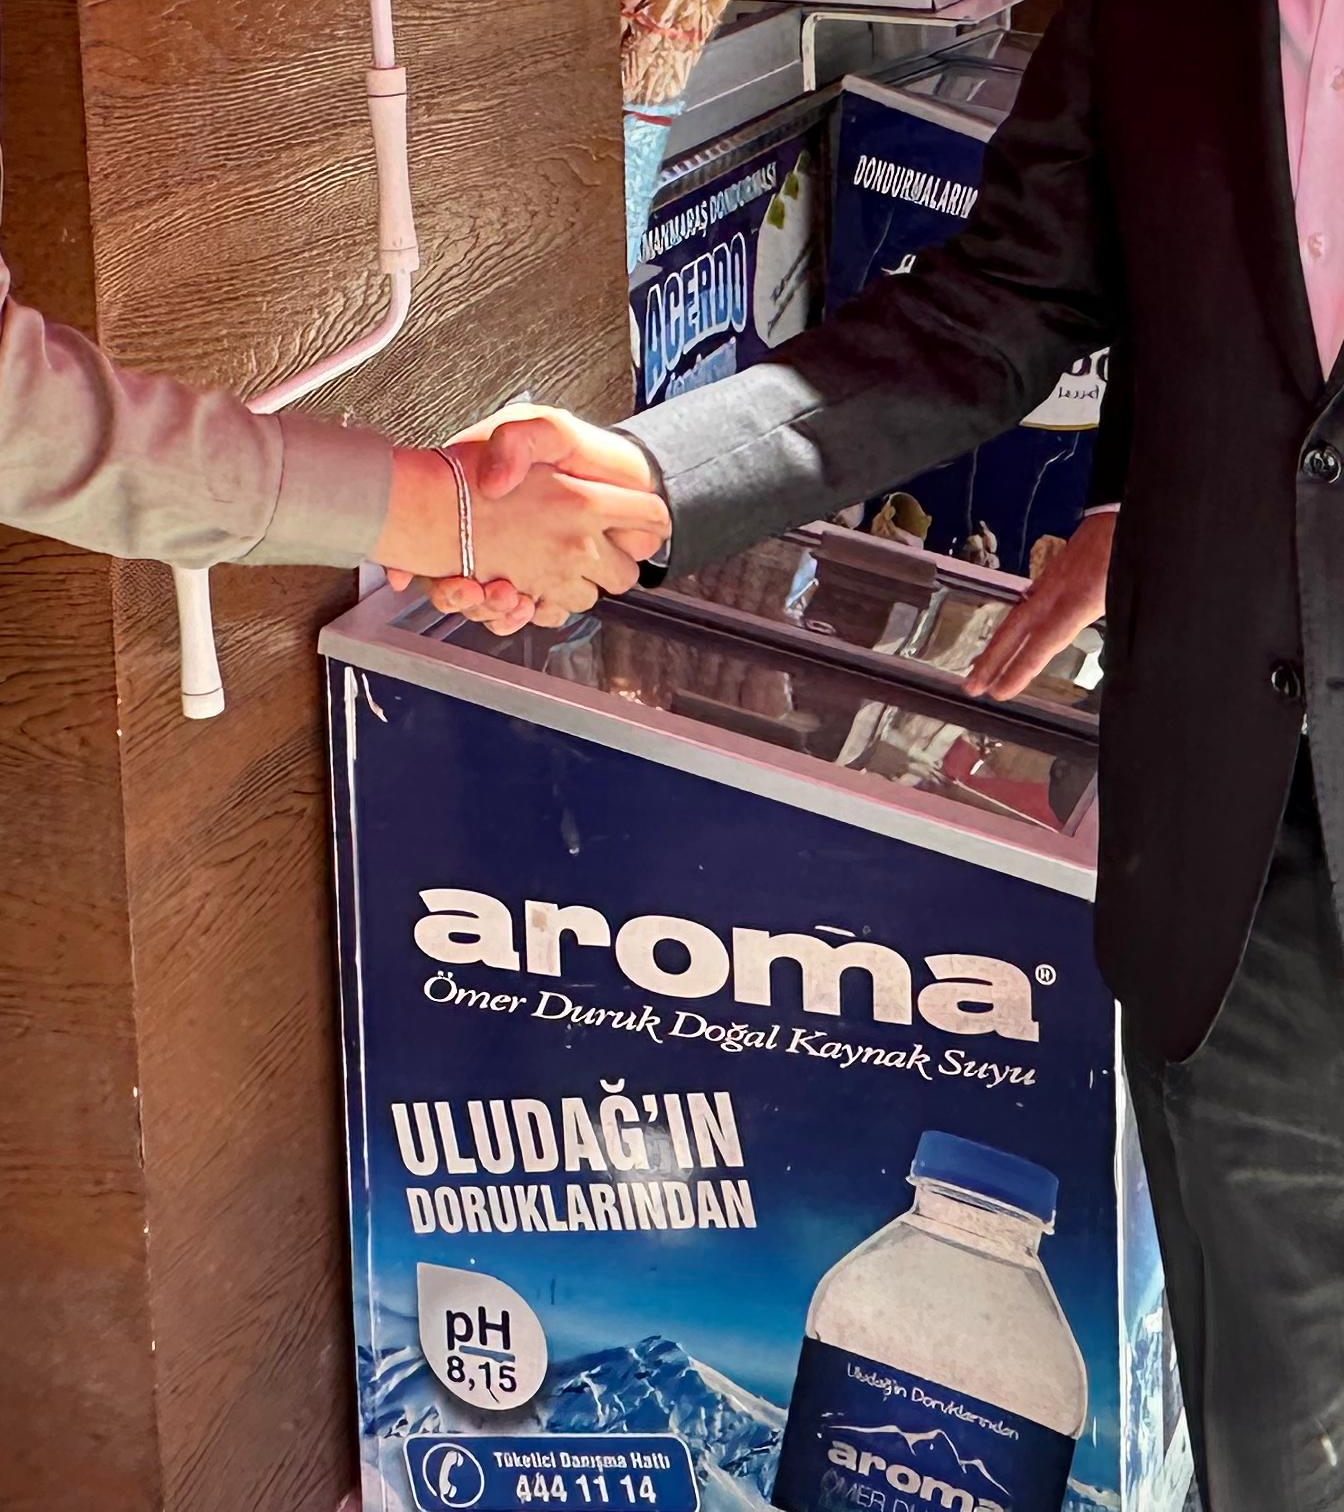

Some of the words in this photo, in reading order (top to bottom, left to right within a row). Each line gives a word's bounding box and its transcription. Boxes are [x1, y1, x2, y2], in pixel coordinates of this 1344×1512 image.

[413, 887, 1041, 1043] aroma
[423, 969, 527, 1013] Ömer
[530, 989, 664, 1044] Duruk
[668, 1010, 781, 1053] Doğal
[786, 1026, 934, 1080] Kaynak
[937, 1049, 1037, 1088] Suyu
[390, 1077, 745, 1177] ULUDAĞ'IN
[405, 1178, 758, 1234] DORUKLARINDAN
[445, 1305, 511, 1351] pH
[446, 1354, 517, 1394] 8,15
[493, 1450, 555, 1469] Tüketici
[559, 1451, 628, 1473] Danışma
[515, 1472, 568, 1504] 444
[575, 1473, 610, 1504] 11
[619, 1474, 657, 1504] 14
